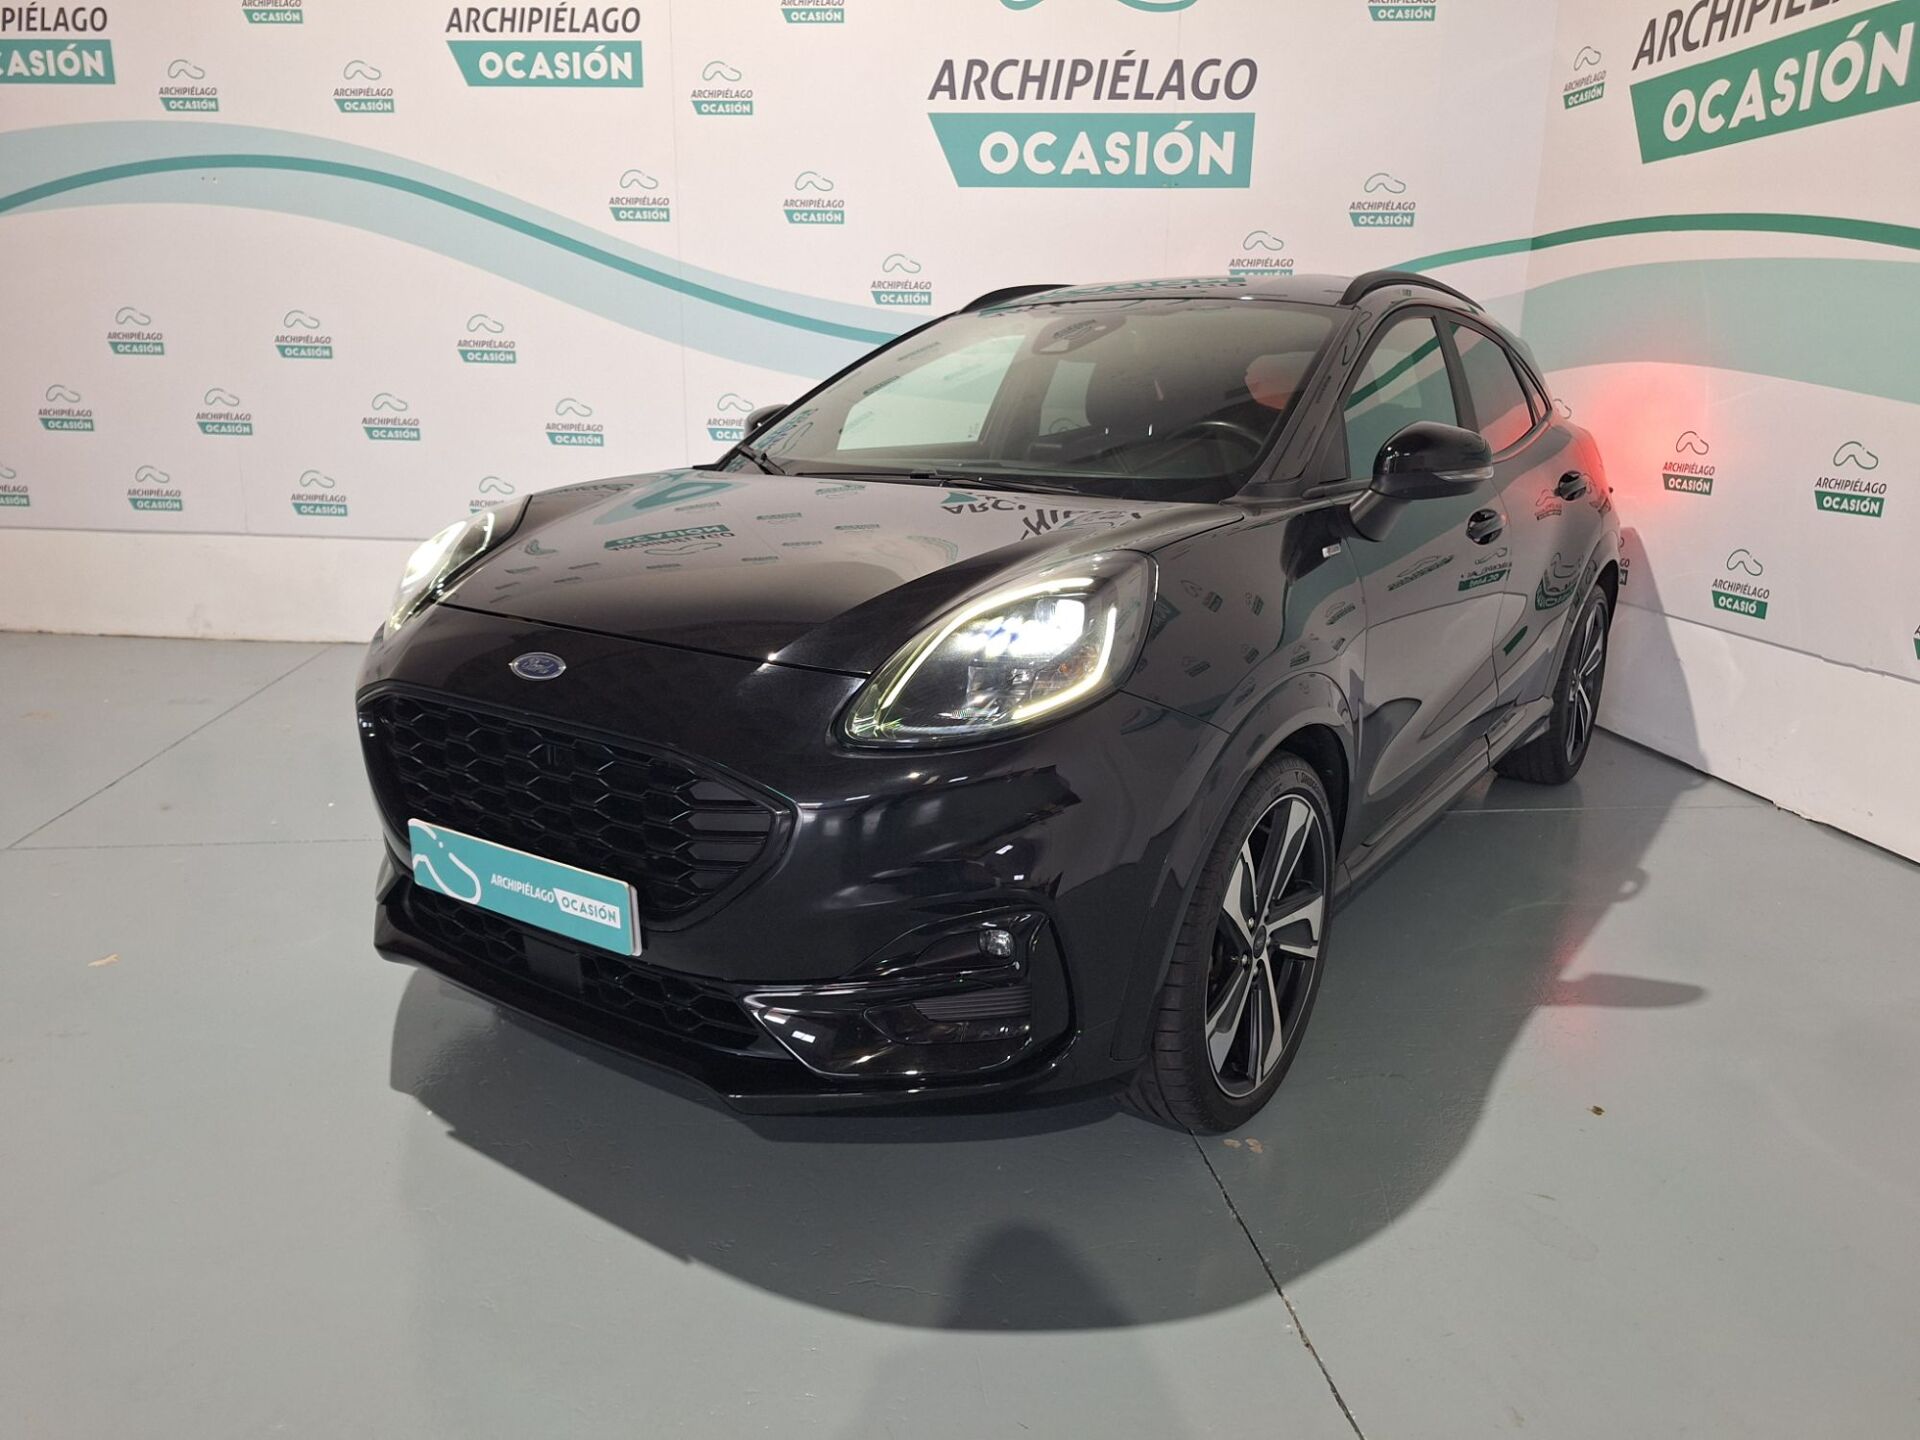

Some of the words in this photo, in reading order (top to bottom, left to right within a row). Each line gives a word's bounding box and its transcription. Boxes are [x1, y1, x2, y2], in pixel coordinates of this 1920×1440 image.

[2, 1, 108, 32] PIÉLAGO
[252, 10, 300, 21] OCASIÓN
[445, 2, 641, 33] ARCHIPIÉLAGO
[790, 10, 842, 21] OCASIÓN
[1377, 8, 1433, 19] OCASIÓN
[0, 43, 105, 77] ASIÓN
[478, 45, 633, 80] OCASIÓN
[928, 49, 1258, 101] ARCHIPIÉLAGO
[1663, 20, 1915, 142] OCASIÓN
[159, 87, 217, 96] ARCHIPIÉLAGO
[333, 87, 393, 96] ARCHIPIÉLAGO
[691, 88, 753, 98] ARCHIPIÉLAGO
[1568, 86, 1603, 106] OCASIÓN
[169, 100, 216, 110] OCASIÓN
[344, 100, 391, 110] OCASIÓN
[701, 102, 750, 113] OCASIÓN
[979, 120, 1236, 176] OCASIÓN
[609, 196, 669, 206] ARCHIPIÉLAGO
[783, 198, 844, 208] ARCHIPIÉLAGO
[1349, 200, 1416, 211] ARCHIPIÉLAGO
[619, 209, 667, 219] OCASIÓN
[793, 211, 841, 222] OCASIÓN
[1359, 213, 1411, 225] OCASIÓN
[1229, 257, 1294, 267] ARCHIPIÉLAGO
[871, 280, 932, 290] ARCHIPIÉLAGO
[880, 293, 928, 303] OCASIÓN
[107, 332, 162, 341] ARCHIPIÉLAGO
[275, 335, 331, 344] ARCHIPIÉLAGO
[117, 343, 161, 353] OCASIÓN
[456, 339, 516, 349] ARCHIPIÉLAGO
[285, 346, 330, 357] OCASIÓN
[467, 351, 514, 362] OCASIÓN
[38, 408, 92, 417] ARCHIPIÉLAGO
[195, 412, 251, 421] ARCHIPIÉLAGO
[48, 420, 91, 430] OCASIÓN
[361, 416, 420, 426] ARCHIPIÉLAGO
[205, 424, 250, 433] OCASIÓN
[545, 422, 603, 432] ARCHIPIÉLAGO
[372, 428, 418, 439] OCASIÓN
[555, 434, 602, 445] OCASIÓN
[1663, 462, 1715, 475] ARCHIPIÉLAGO
[1668, 478, 1710, 493] OCASIÓN
[1815, 476, 1887, 494] ARCHIPIÉLAGO
[127, 488, 181, 497] ARCHIPIÉLAGO
[290, 493, 346, 503] ARCHIPIÉLAGO
[136, 499, 180, 509] OCASIÓN
[300, 504, 345, 515] OCASIÓN
[1823, 497, 1880, 514] OCASIÓN
[1712, 578, 1770, 599] ARCHIPIÉLAGO
[1718, 596, 1757, 614] OCASIÓ
[491, 873, 554, 903] ARCHIPIÉLAGO
[561, 896, 617, 923] OCASIÓN
